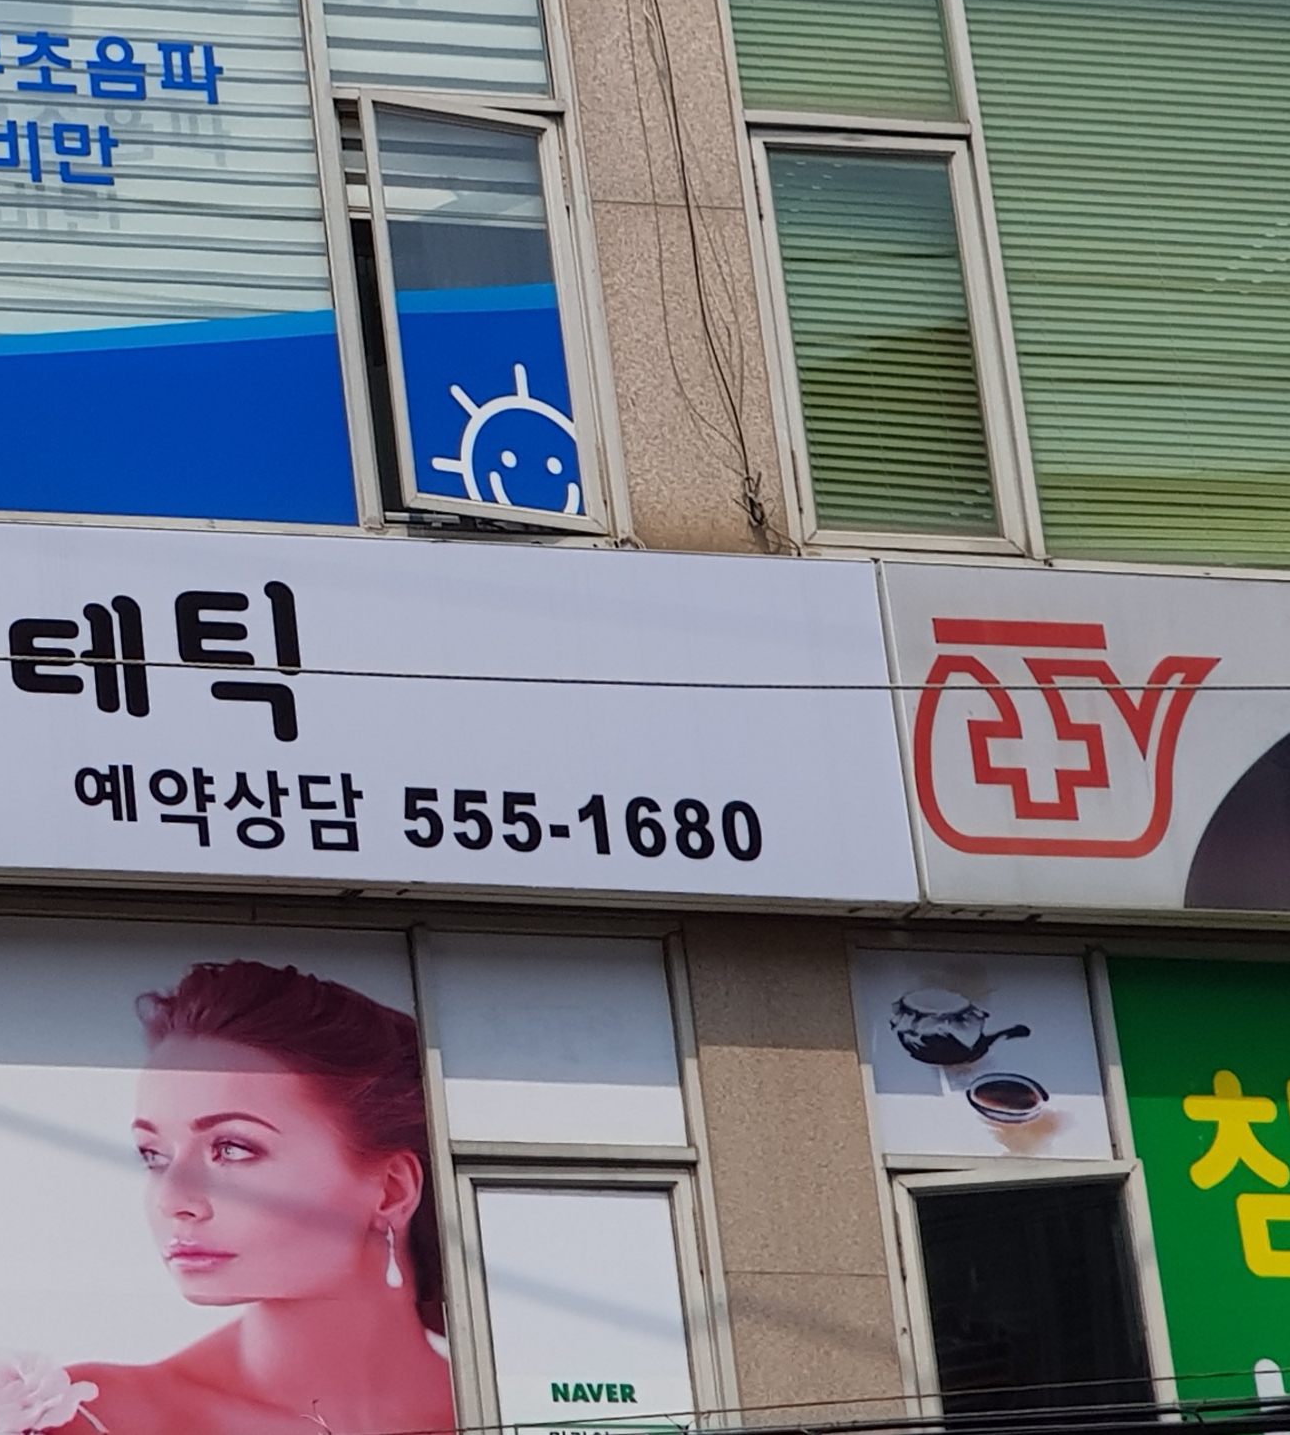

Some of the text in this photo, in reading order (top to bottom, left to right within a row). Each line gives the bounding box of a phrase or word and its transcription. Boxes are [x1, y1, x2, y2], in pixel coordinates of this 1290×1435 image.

[74, 764, 763, 862] 예약상담 555-1680
[550, 1382, 638, 1403] NAVER
